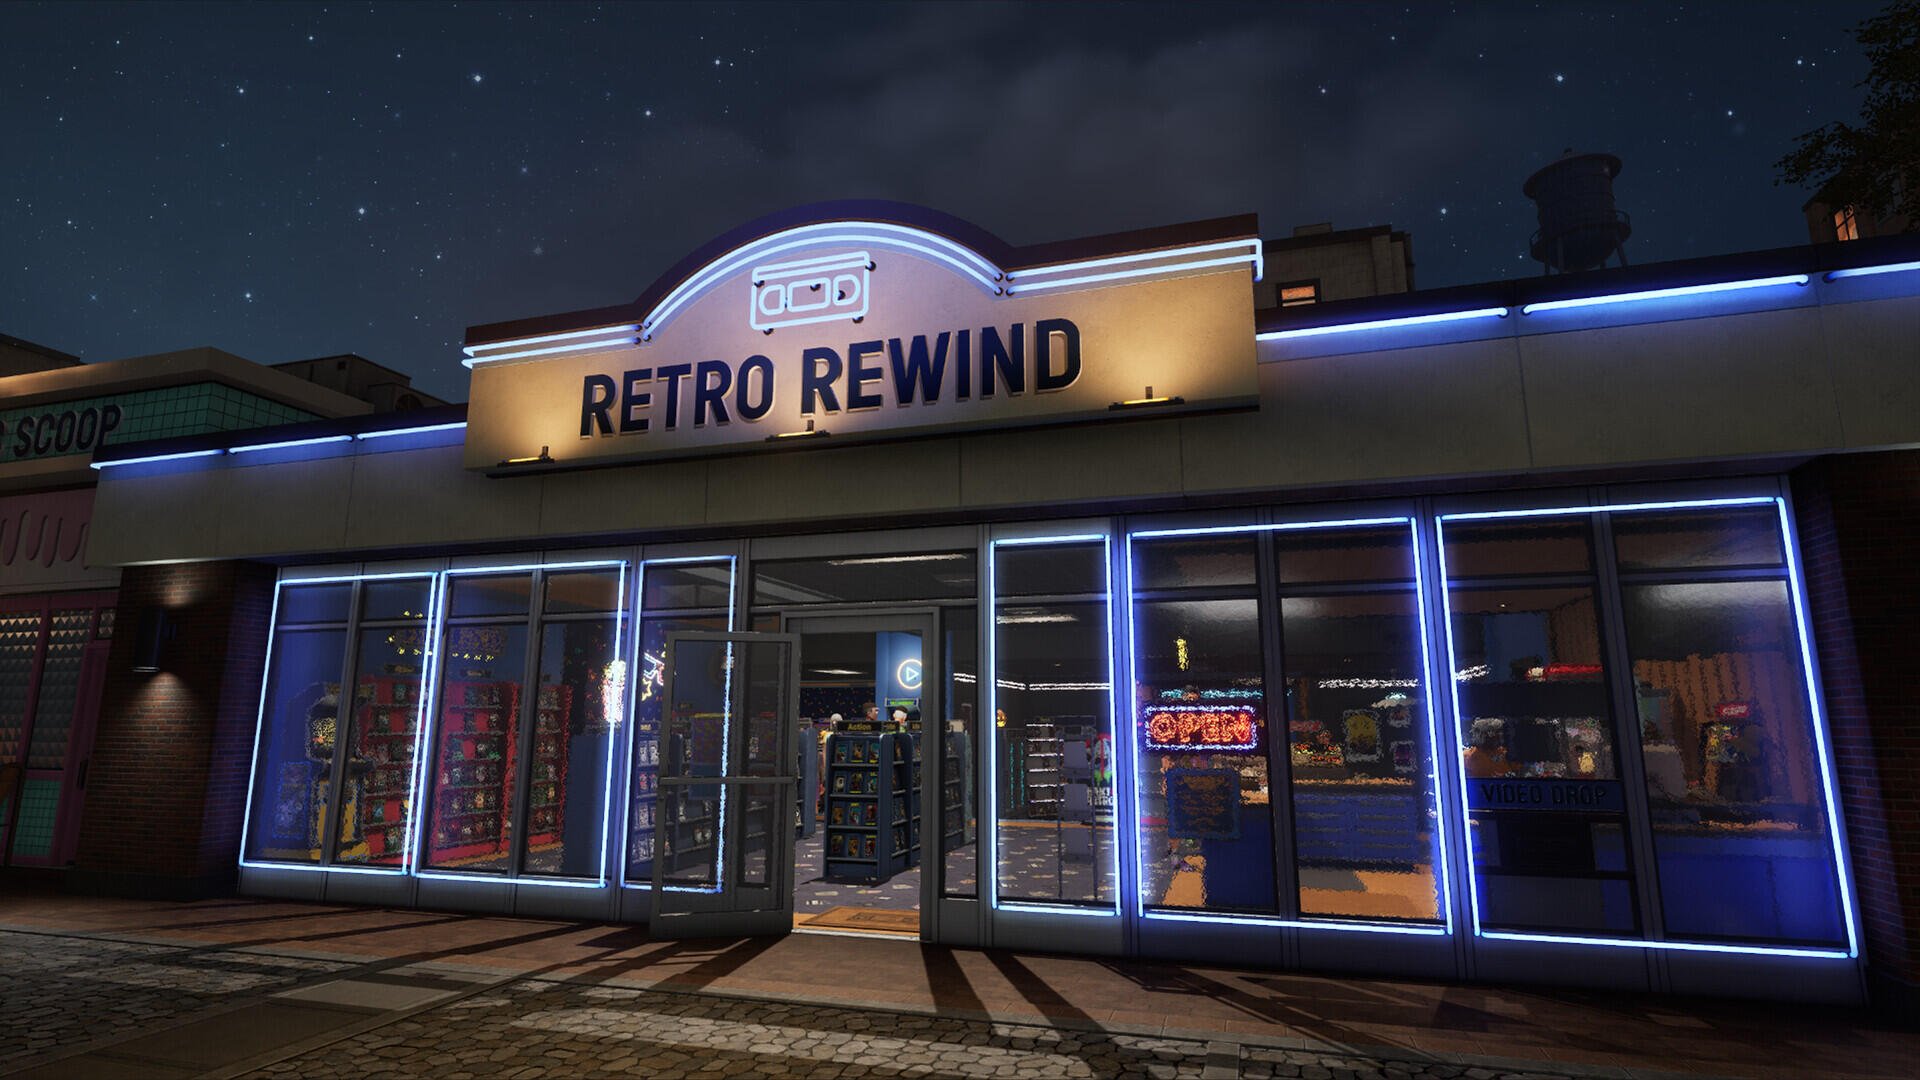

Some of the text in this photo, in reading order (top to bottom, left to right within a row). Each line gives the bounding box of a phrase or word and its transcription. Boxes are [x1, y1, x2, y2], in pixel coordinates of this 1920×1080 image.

[580, 317, 1083, 439] RETRO REWIND
[14, 404, 121, 457] SCOOP
[1149, 711, 1252, 743] OPEN
[1481, 784, 1607, 806] VIDEO DROP
